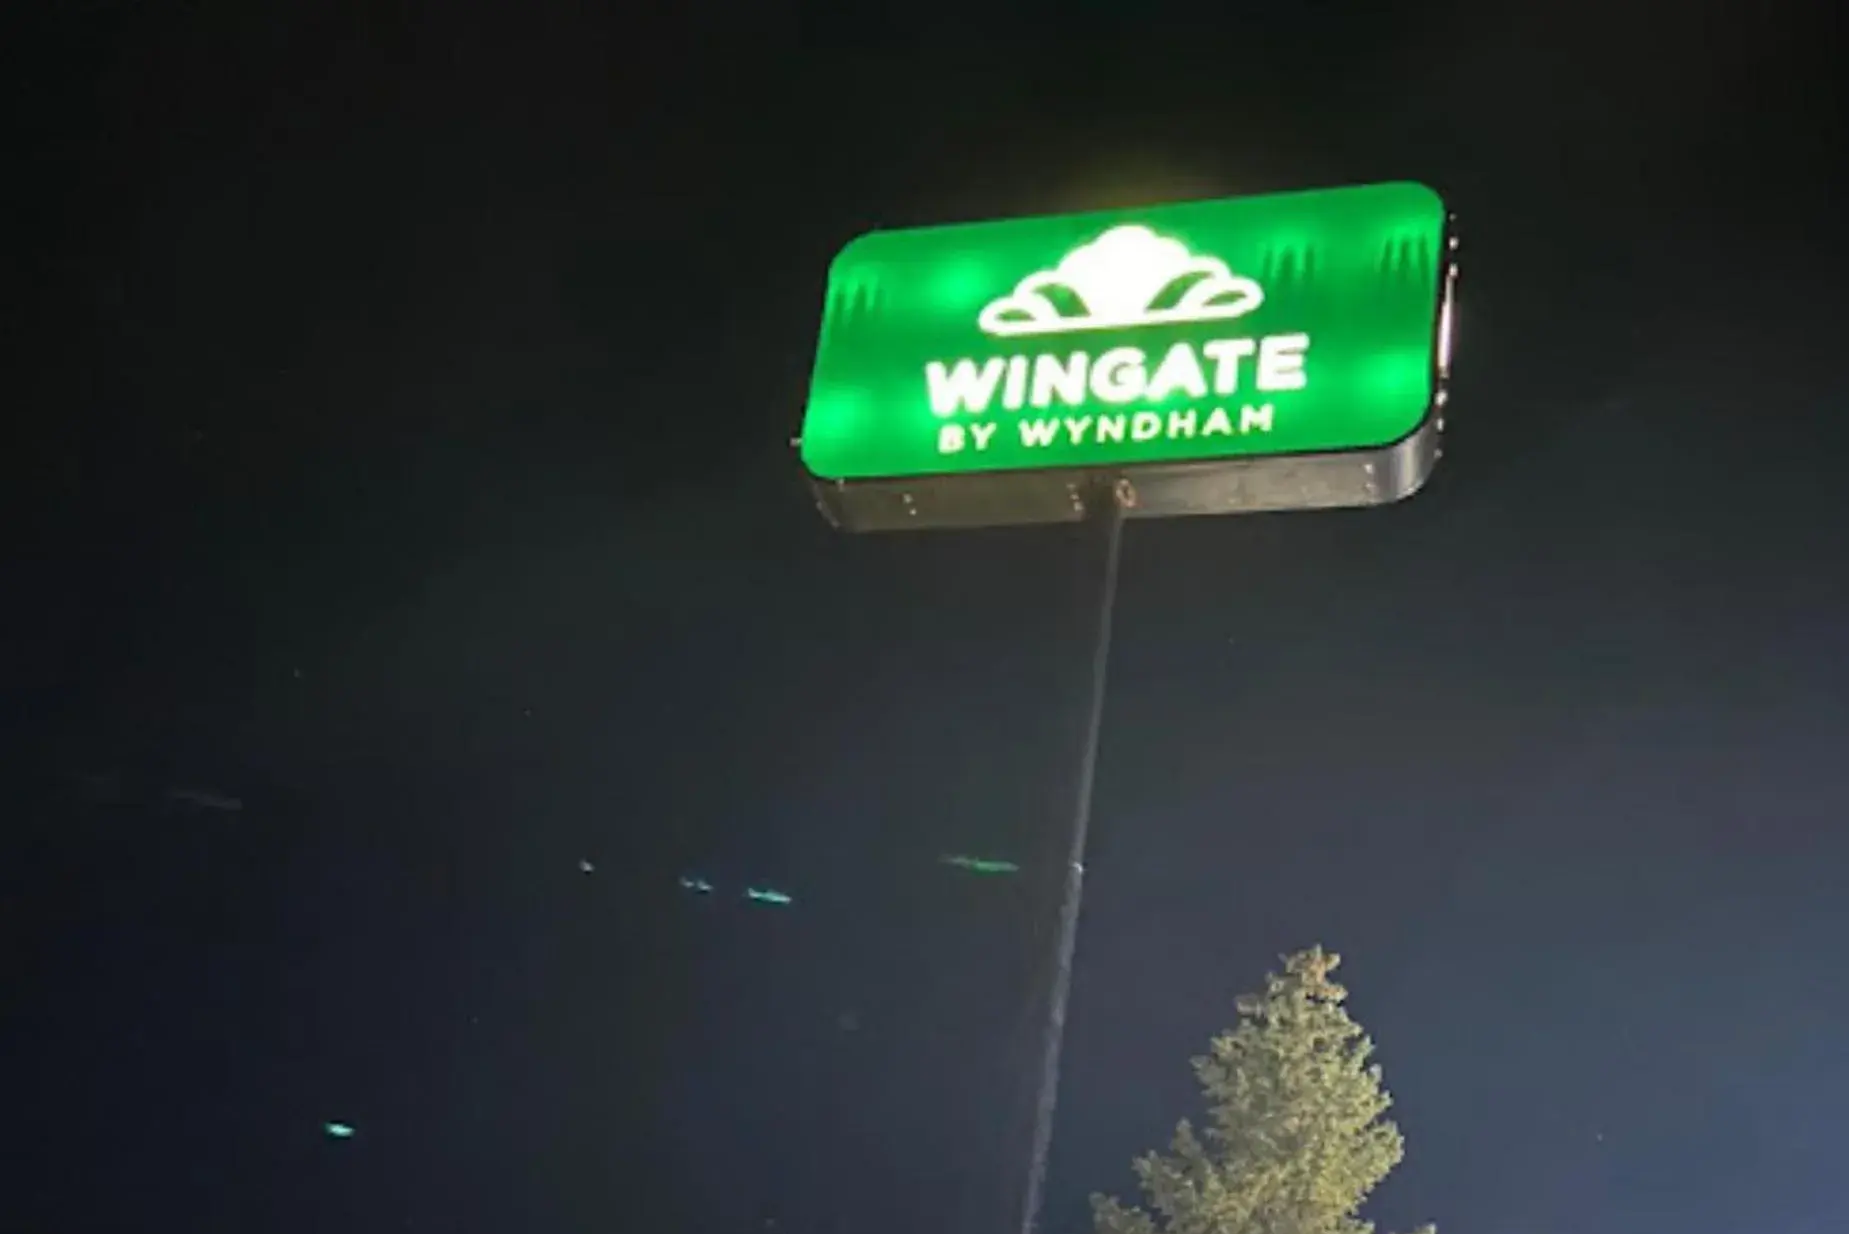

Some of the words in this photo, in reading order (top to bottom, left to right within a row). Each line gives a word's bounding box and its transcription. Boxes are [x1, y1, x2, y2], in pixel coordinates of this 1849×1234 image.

[926, 334, 1309, 416] WINGATE
[938, 422, 995, 454] BY
[1018, 404, 1273, 447] WYNDHAM
